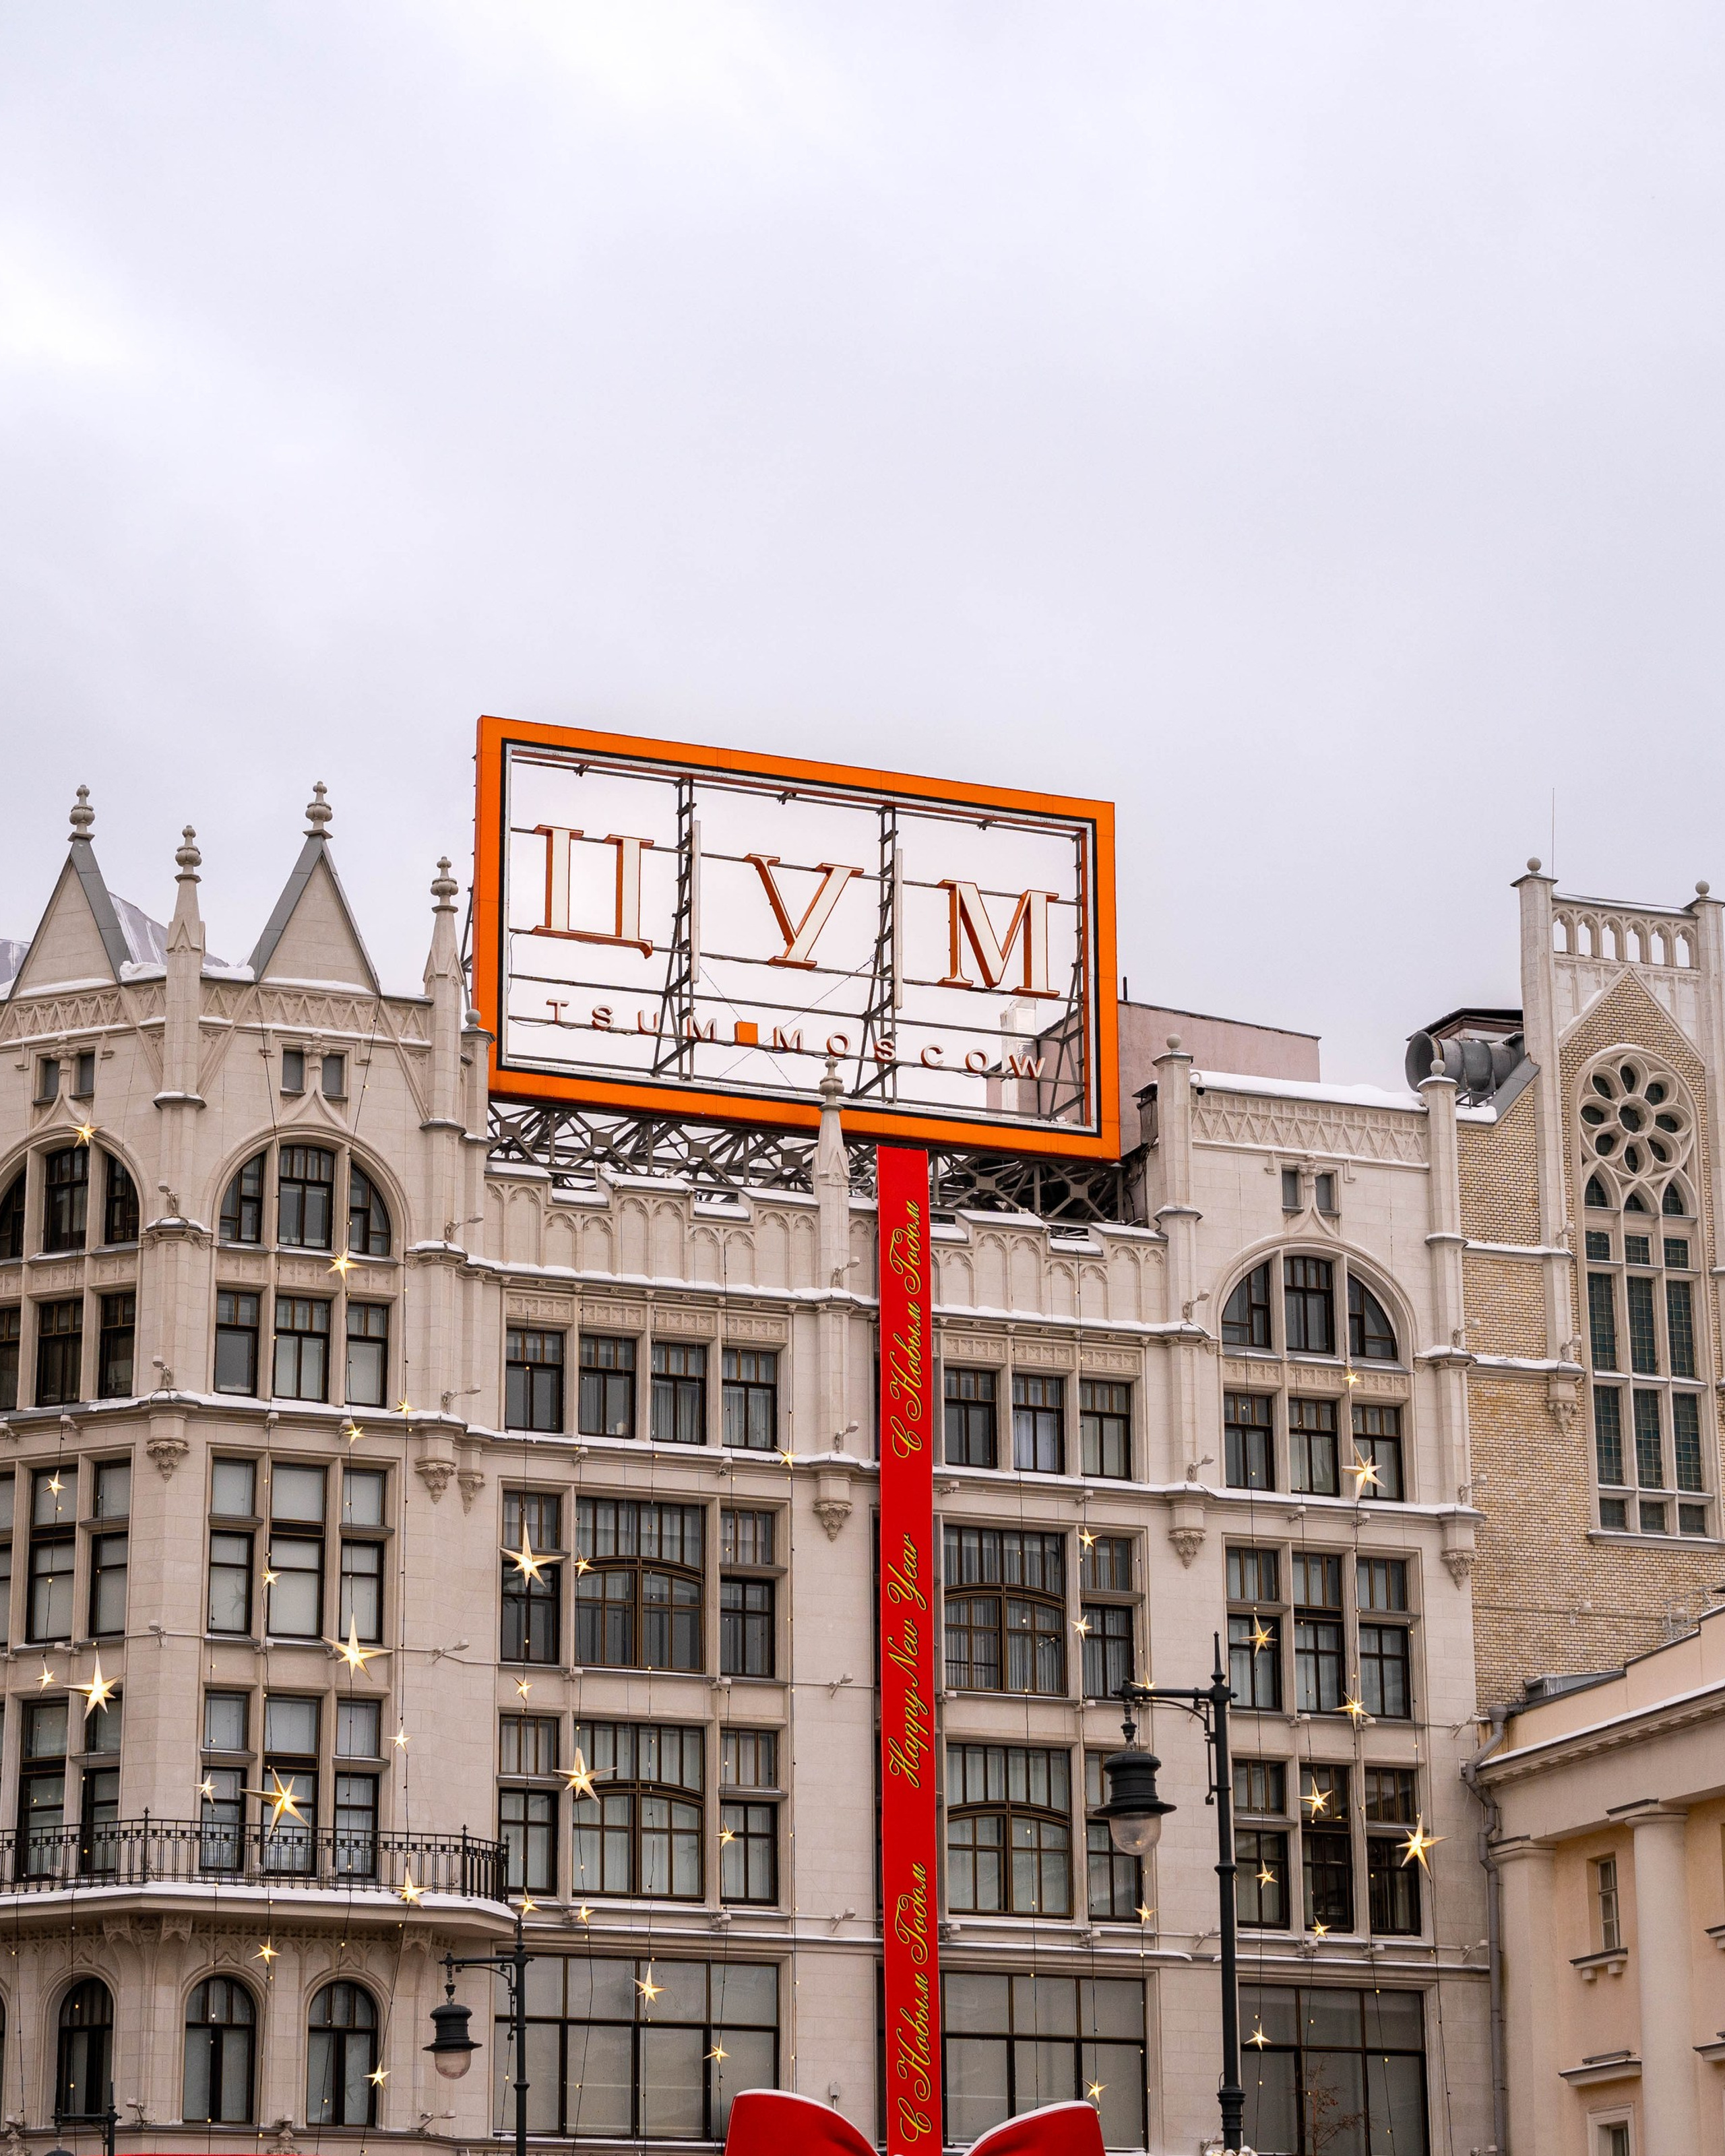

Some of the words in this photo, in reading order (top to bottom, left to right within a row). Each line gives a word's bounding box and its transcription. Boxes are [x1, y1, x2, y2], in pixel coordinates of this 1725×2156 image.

[532, 824, 1061, 999] ЦУМ
[546, 998, 718, 1042] TSUM
[772, 1026, 1046, 1080] MOSCOW
[888, 1199, 922, 1294] Годом
[889, 1301, 922, 1421] Новым
[890, 1416, 923, 1458] С
[886, 1533, 928, 1610] Year
[887, 1618, 919, 1686] New
[887, 1688, 929, 1788] Happy
[894, 1862, 929, 1965] Годом
[896, 1971, 932, 2101] Новым
[897, 2096, 932, 2142] С
